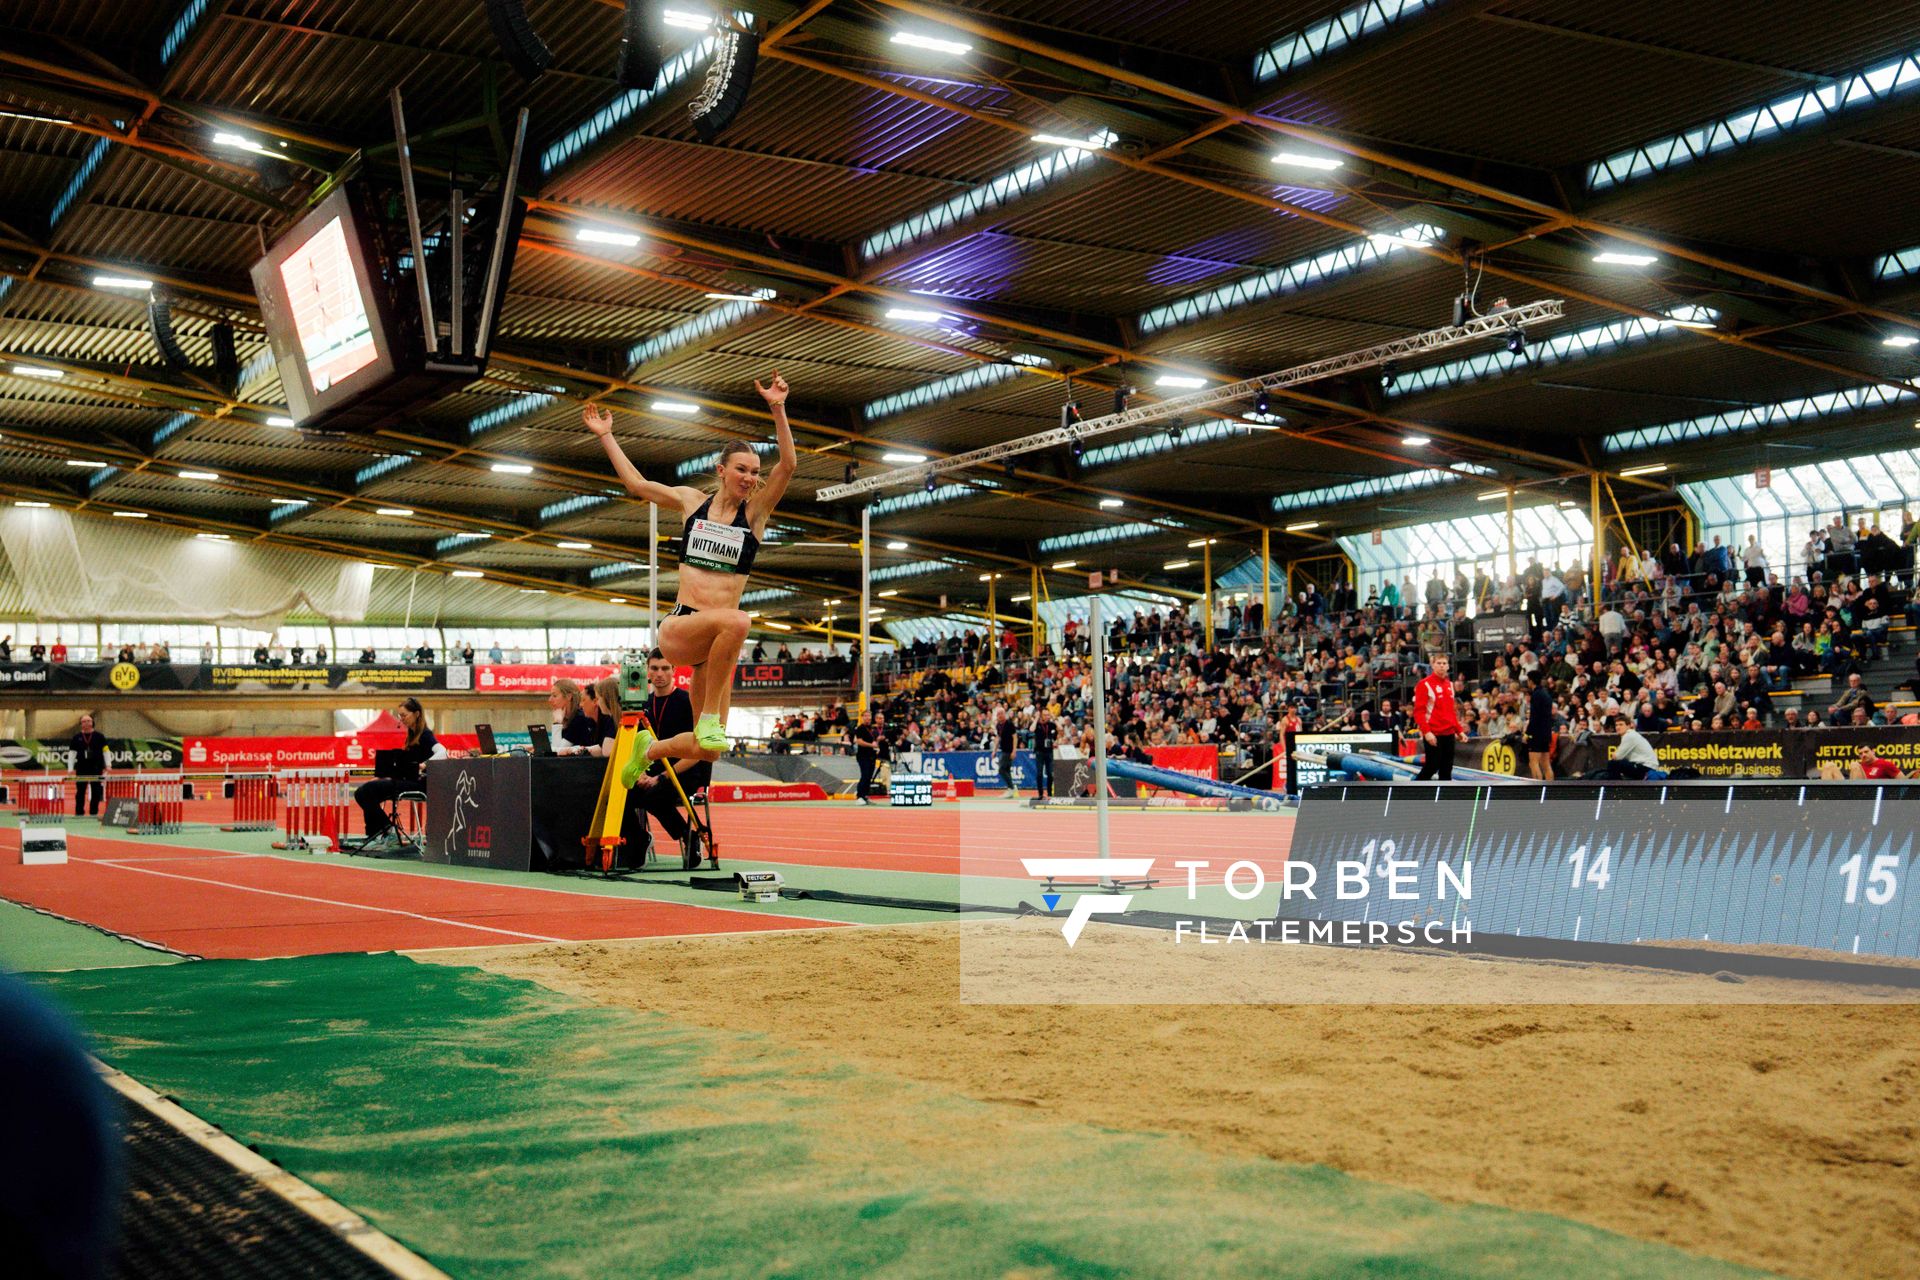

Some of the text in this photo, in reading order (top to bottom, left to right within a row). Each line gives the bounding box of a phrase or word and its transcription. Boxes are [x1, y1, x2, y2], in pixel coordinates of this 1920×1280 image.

[692, 537, 740, 560] WITTMANN
[0, 671, 46, 681] he Game!
[115, 666, 136, 681] BVB
[212, 668, 329, 677] BVBBusinessNetzwerk
[742, 666, 783, 681] LGO
[498, 676, 547, 687] Sparkasse
[136, 750, 172, 762] 2026
[212, 749, 335, 764] Sparkasse Dortmund
[1816, 745, 1852, 757] JETZT
[1488, 746, 1512, 772] BVB
[1707, 764, 1734, 775] mehr
[1735, 763, 1783, 776] Business.
[1297, 771, 1326, 783] EST
[745, 792, 777, 800] Sparkasse
[1362, 838, 1395, 878] 13
[1569, 845, 1611, 889] 14
[1839, 854, 1899, 905] 15
